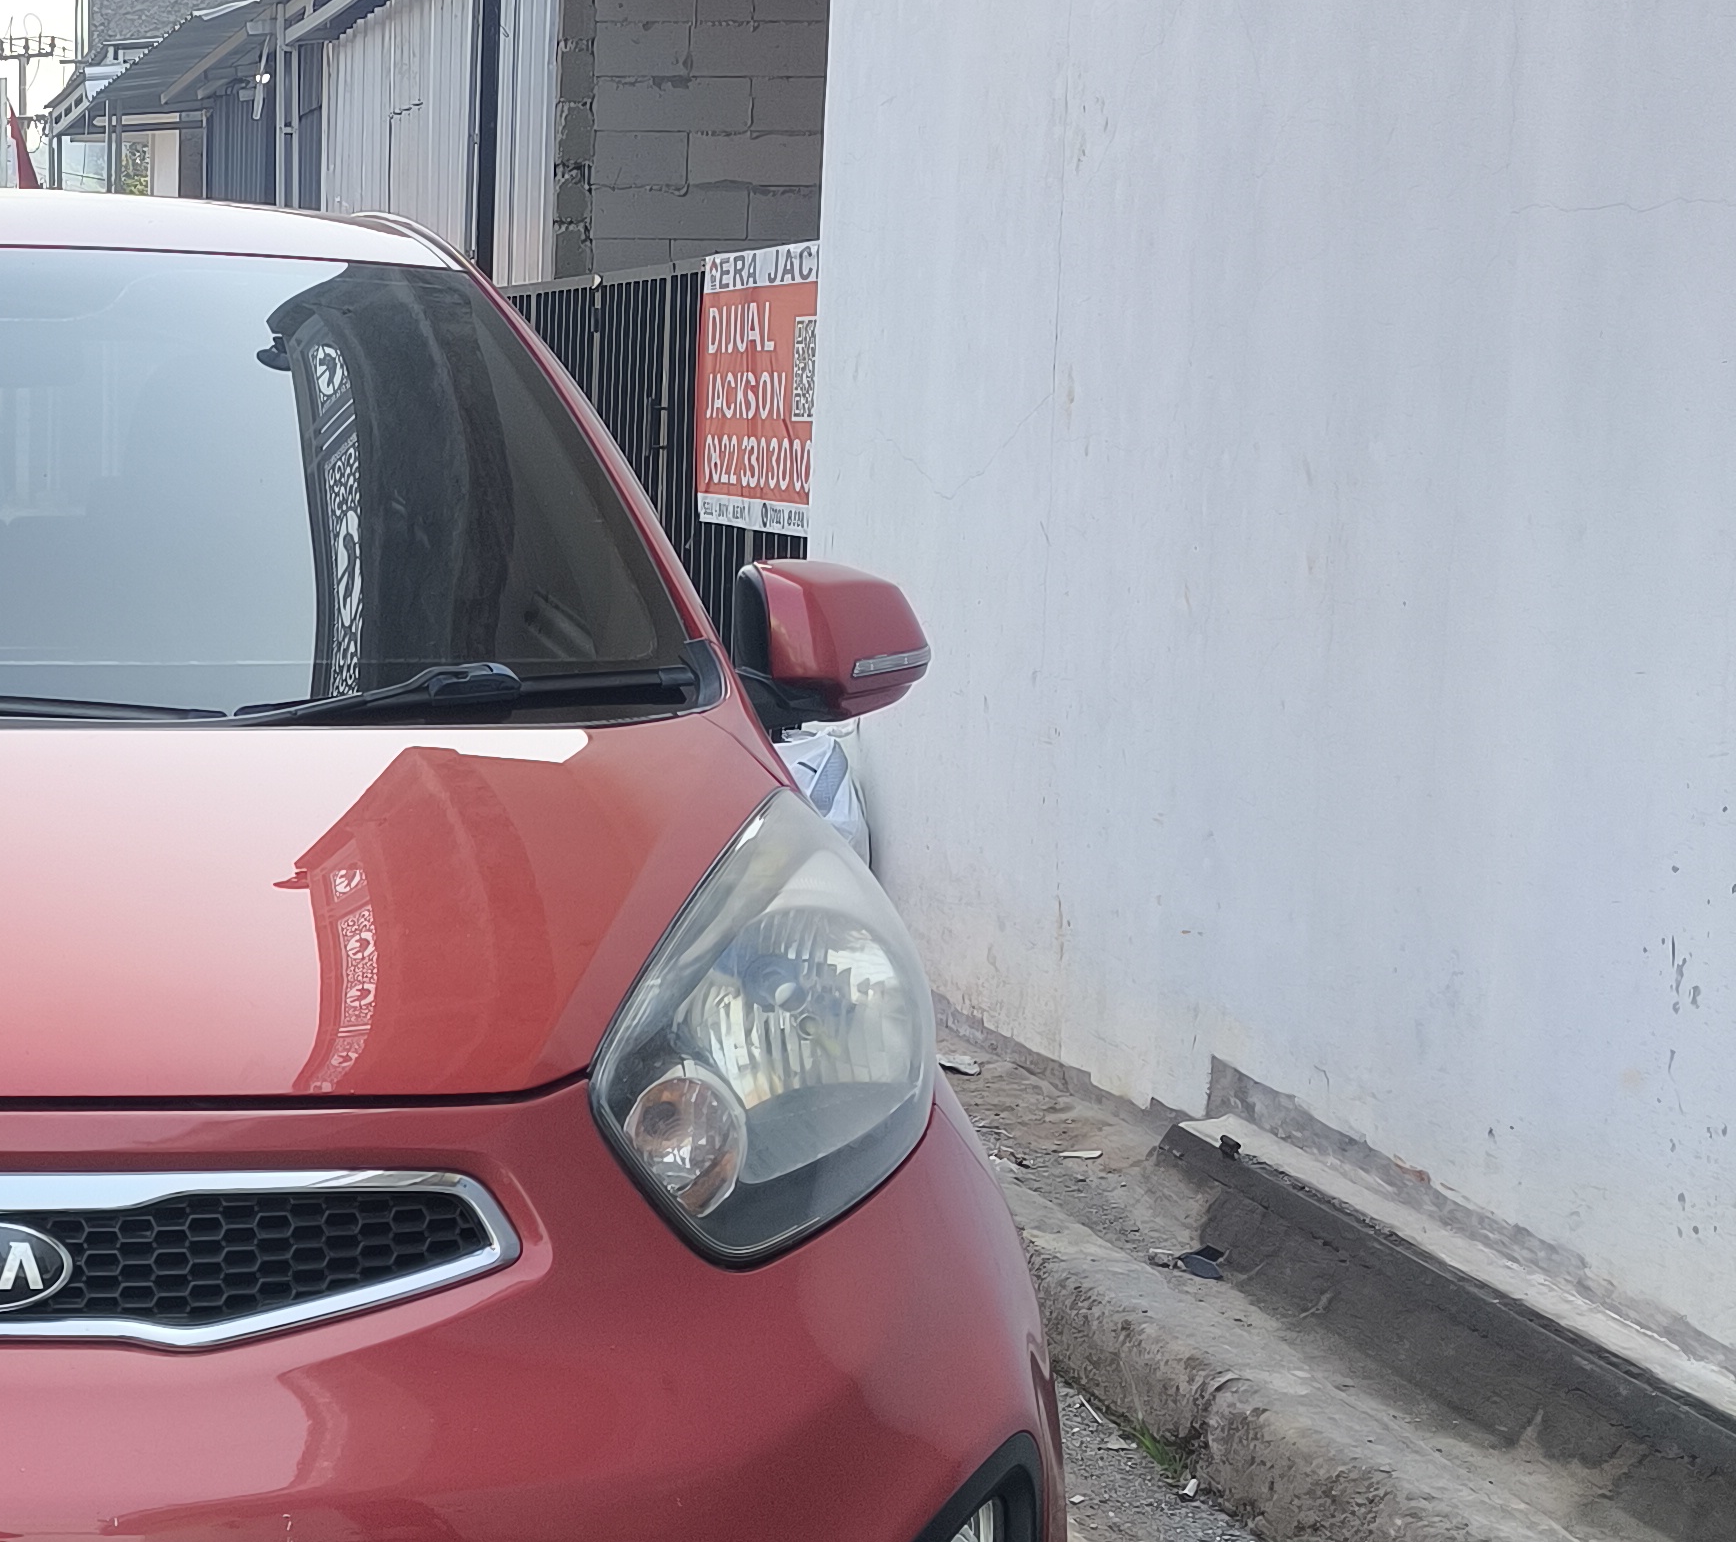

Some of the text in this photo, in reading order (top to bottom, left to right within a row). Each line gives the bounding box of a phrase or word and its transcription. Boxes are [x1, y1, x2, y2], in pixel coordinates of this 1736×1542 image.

[718, 244, 819, 290] ERA JAC
[708, 301, 775, 354] DIJUAL
[706, 371, 786, 419] JACKSON
